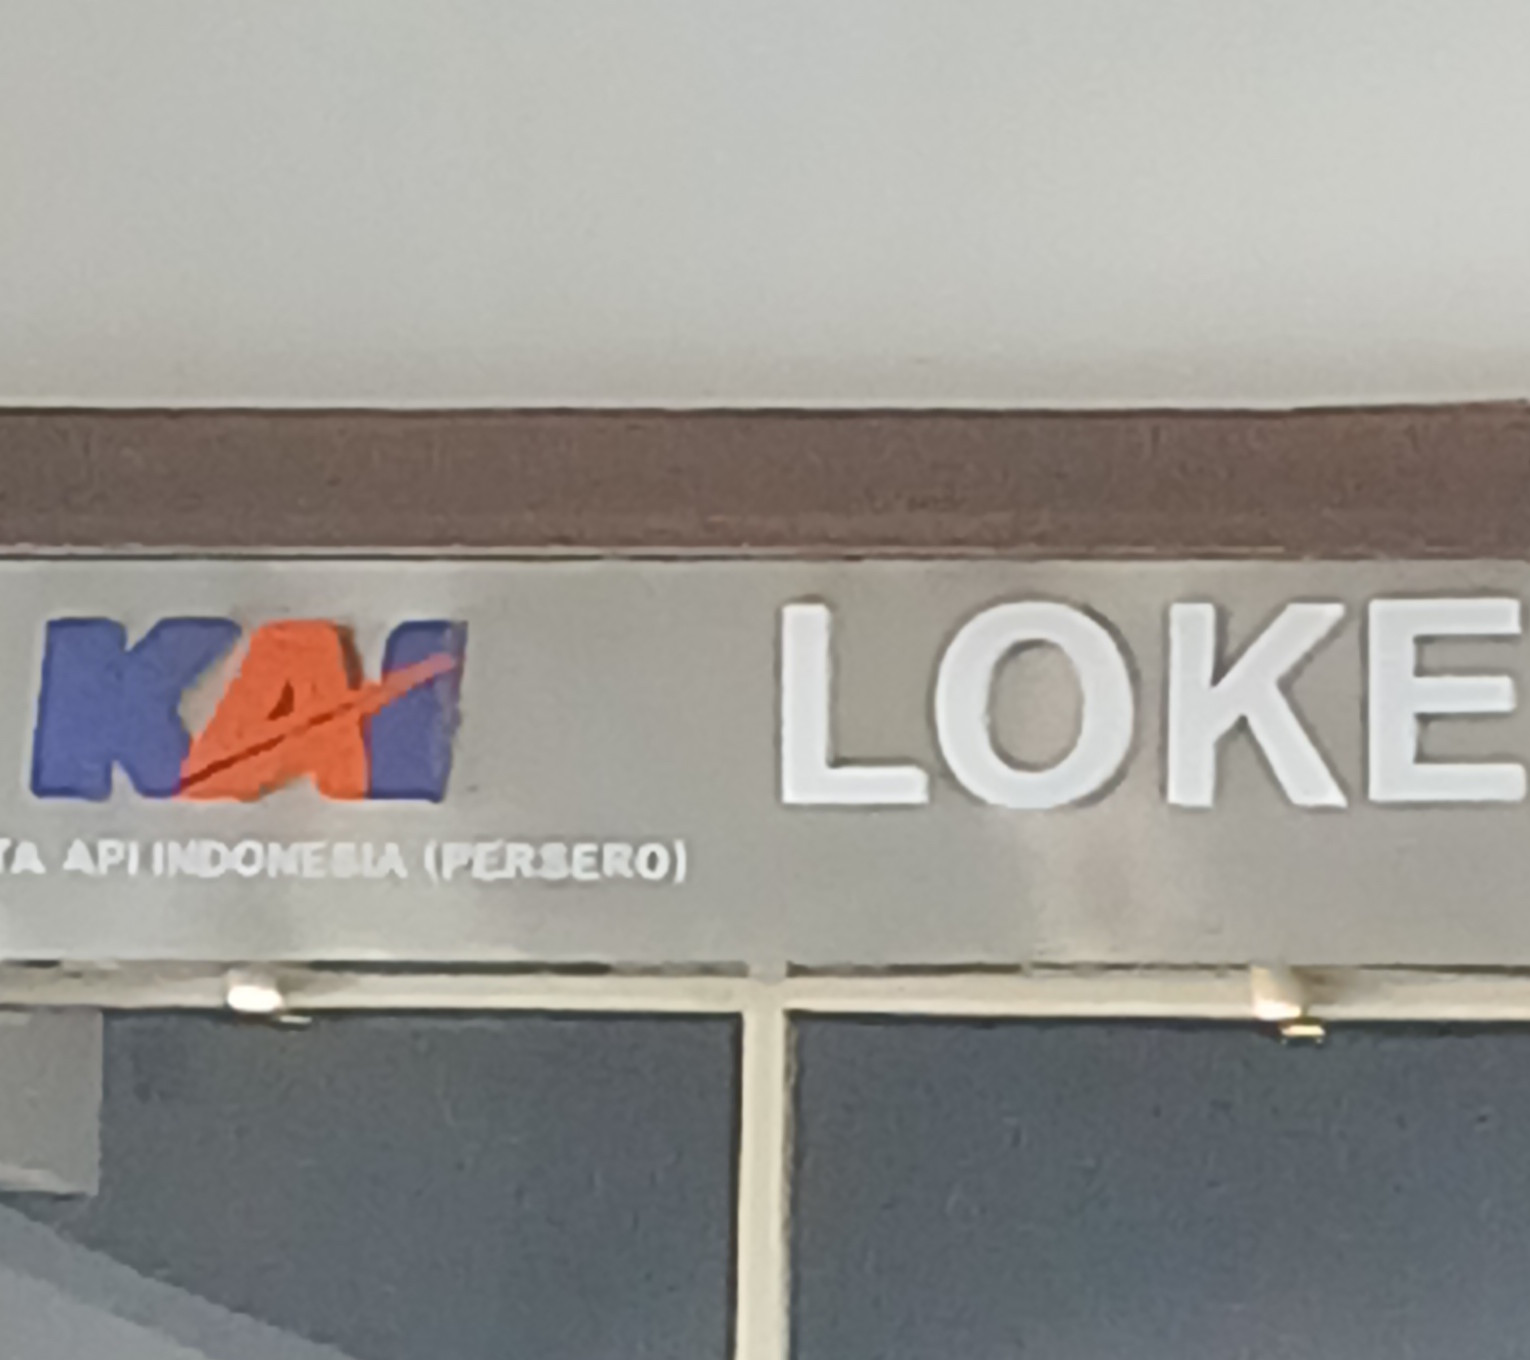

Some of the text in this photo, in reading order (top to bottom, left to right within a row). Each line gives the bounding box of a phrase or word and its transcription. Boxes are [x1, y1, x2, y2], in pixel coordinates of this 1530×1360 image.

[29, 617, 467, 803] KAI
[62, 838, 138, 877] API
[152, 838, 408, 879] INDONESIA
[423, 838, 687, 884] (PERSERO)
